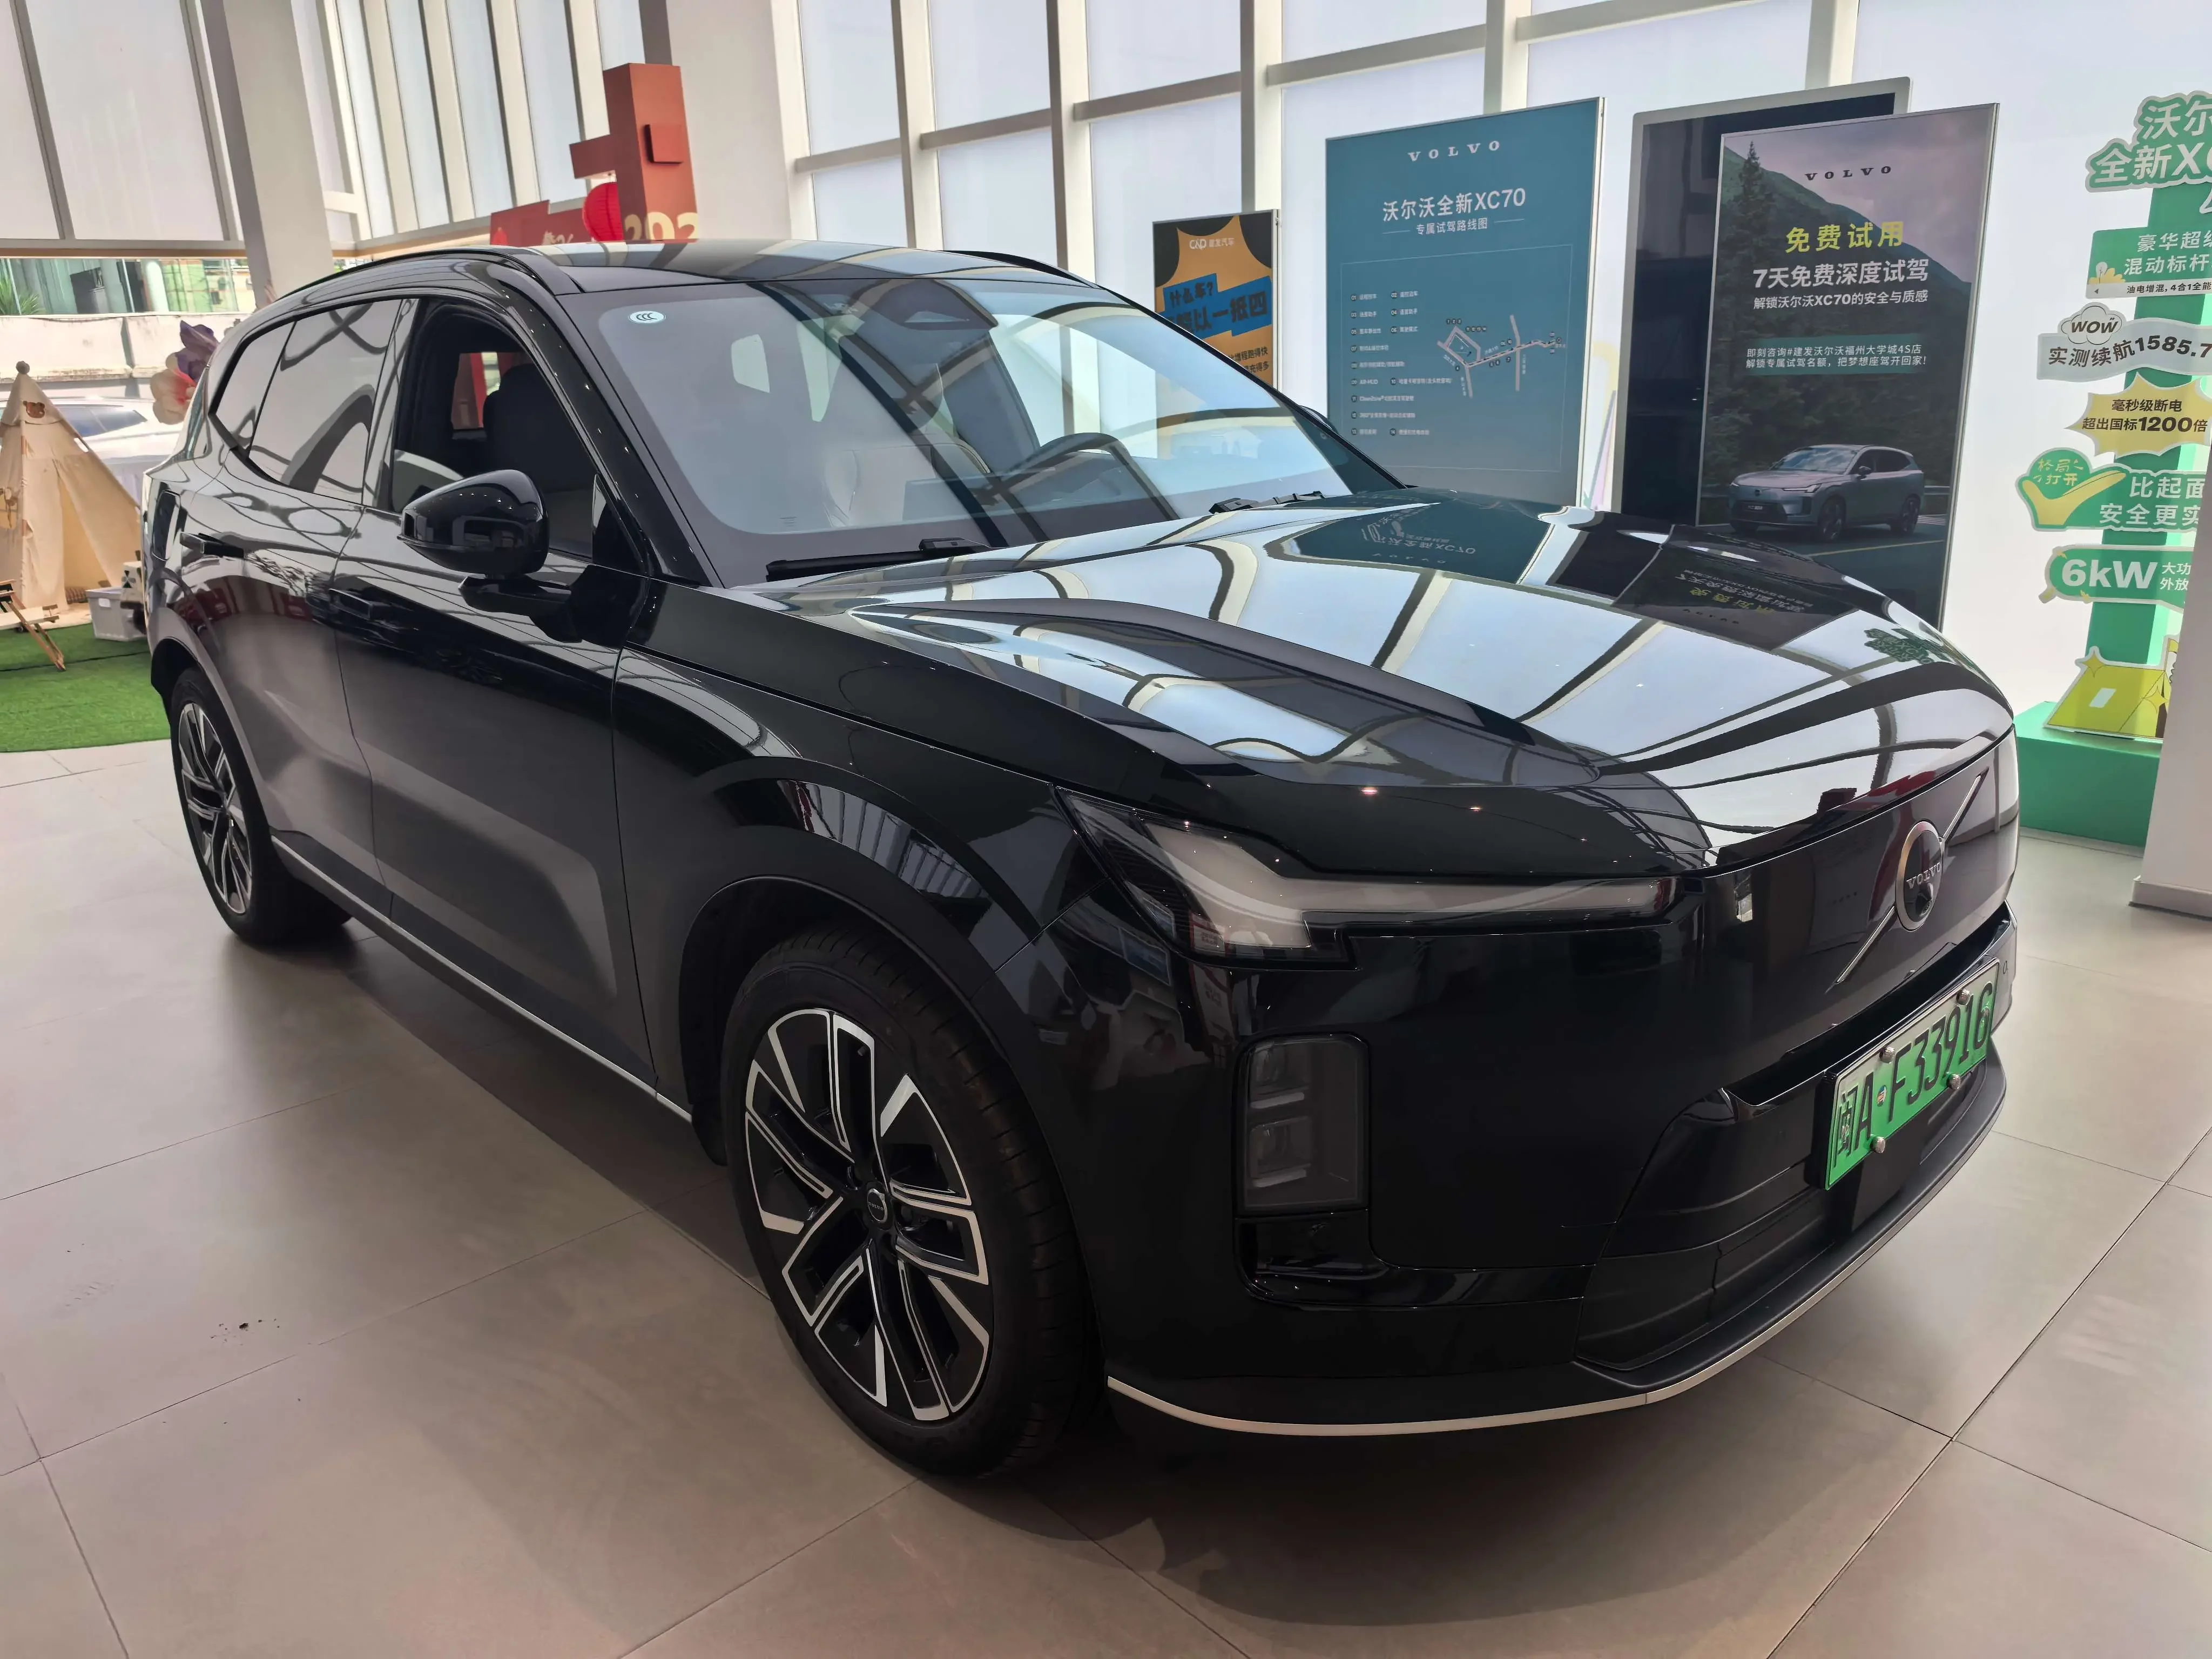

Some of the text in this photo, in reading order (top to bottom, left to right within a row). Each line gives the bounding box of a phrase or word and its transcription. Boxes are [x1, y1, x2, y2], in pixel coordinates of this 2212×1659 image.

[1408, 140, 1500, 162] VOLVO
[2095, 142, 2212, 183] 全新X
[1805, 165, 1891, 181] VOLVO
[1382, 188, 1526, 222] 沃尔沃全新XC70
[1415, 218, 1488, 235] 专属试驾路线图
[1785, 221, 1904, 254] 免费试用
[1752, 258, 1929, 289] 7天免费深度试驾
[2123, 254, 2210, 275] 混动标杆
[1754, 289, 1928, 309] 解锁沃尔沃XC70的安全与质感
[2071, 320, 2118, 334] WOW
[1746, 344, 1921, 358] 即刻咨询#建发沃尔沃福州大学城4S店
[2048, 335, 2212, 368] 实测续航1585.7
[2111, 399, 2182, 413] 毫秒级断电
[2082, 416, 2208, 433] 超出国标1200倍
[2038, 458, 2071, 472] 格局
[2045, 473, 2078, 487] 打开
[2129, 476, 2206, 499] 比起面
[2099, 503, 2201, 527] 安全更实
[2061, 559, 2158, 589] 6kW
[2162, 562, 2192, 575] 大功
[2160, 577, 2189, 591] 外放
[1906, 862, 1941, 889] VOLVO
[868, 1201, 884, 1211] VOLVO
